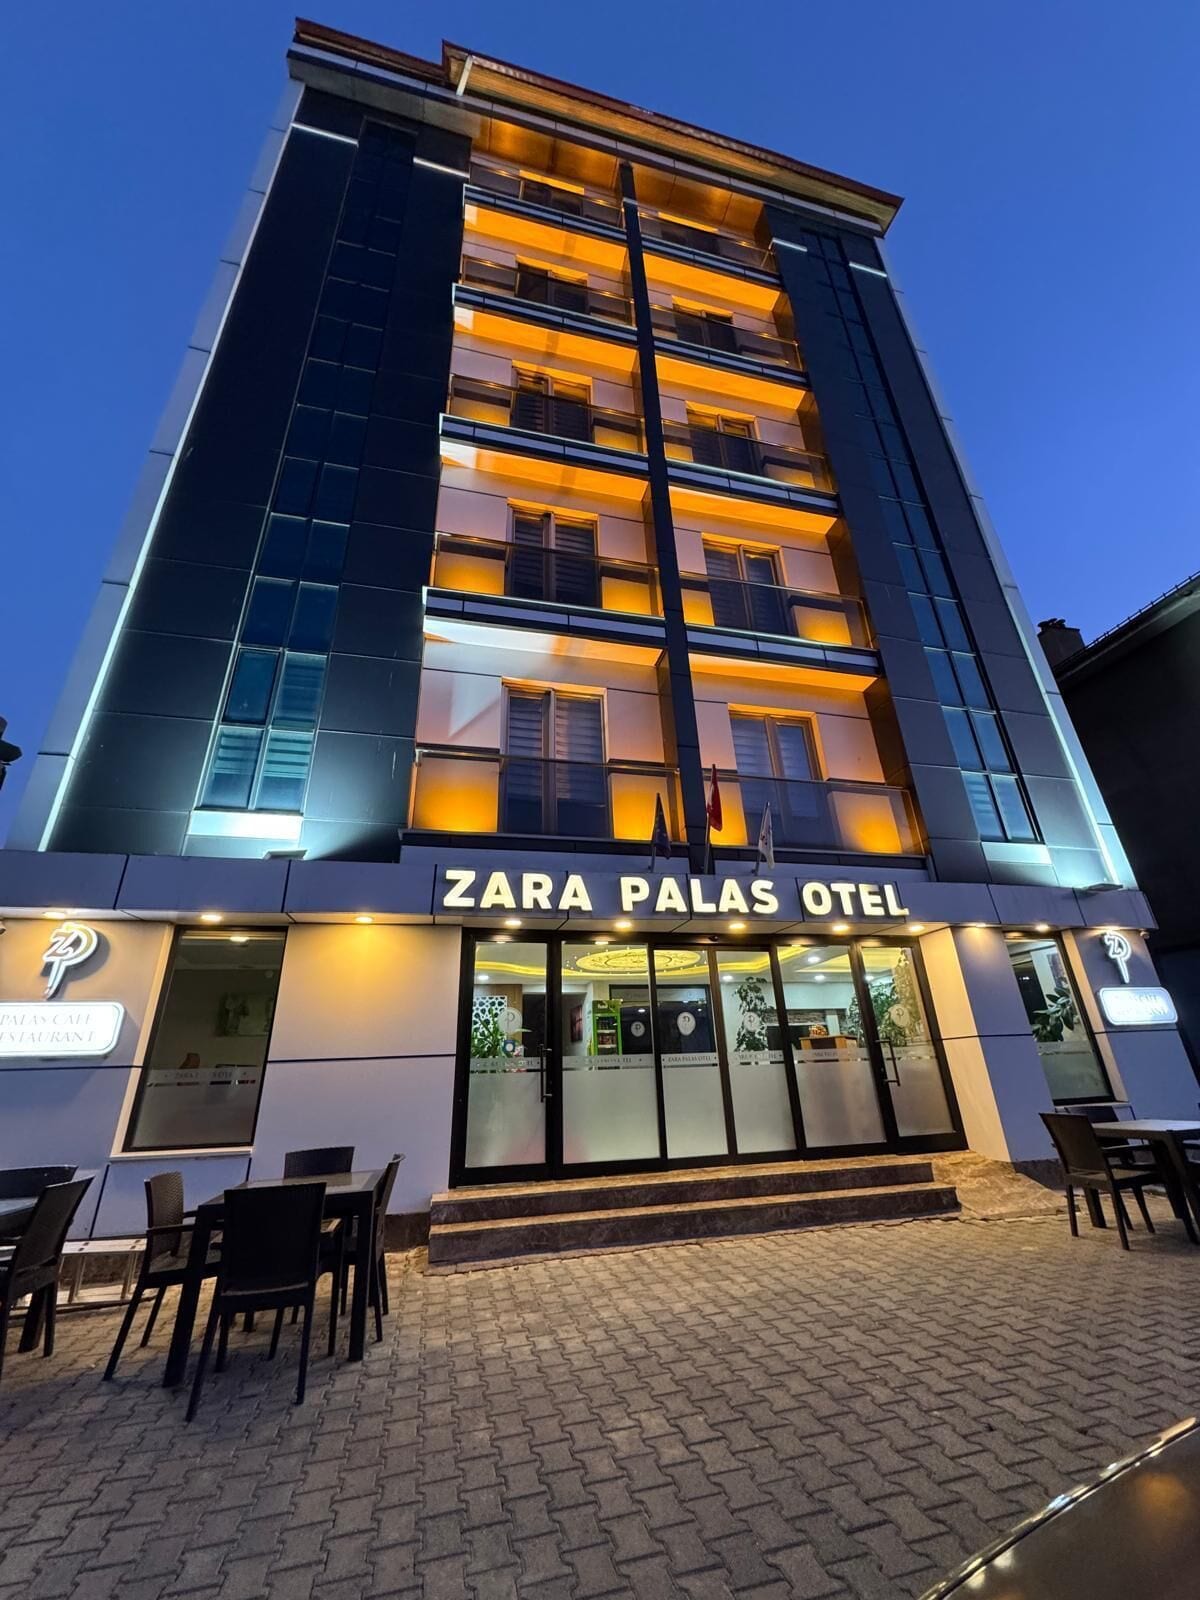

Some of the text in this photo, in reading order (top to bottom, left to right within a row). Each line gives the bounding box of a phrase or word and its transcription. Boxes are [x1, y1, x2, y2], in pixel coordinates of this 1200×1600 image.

[443, 869, 910, 917] ZARA PALAS OTEL
